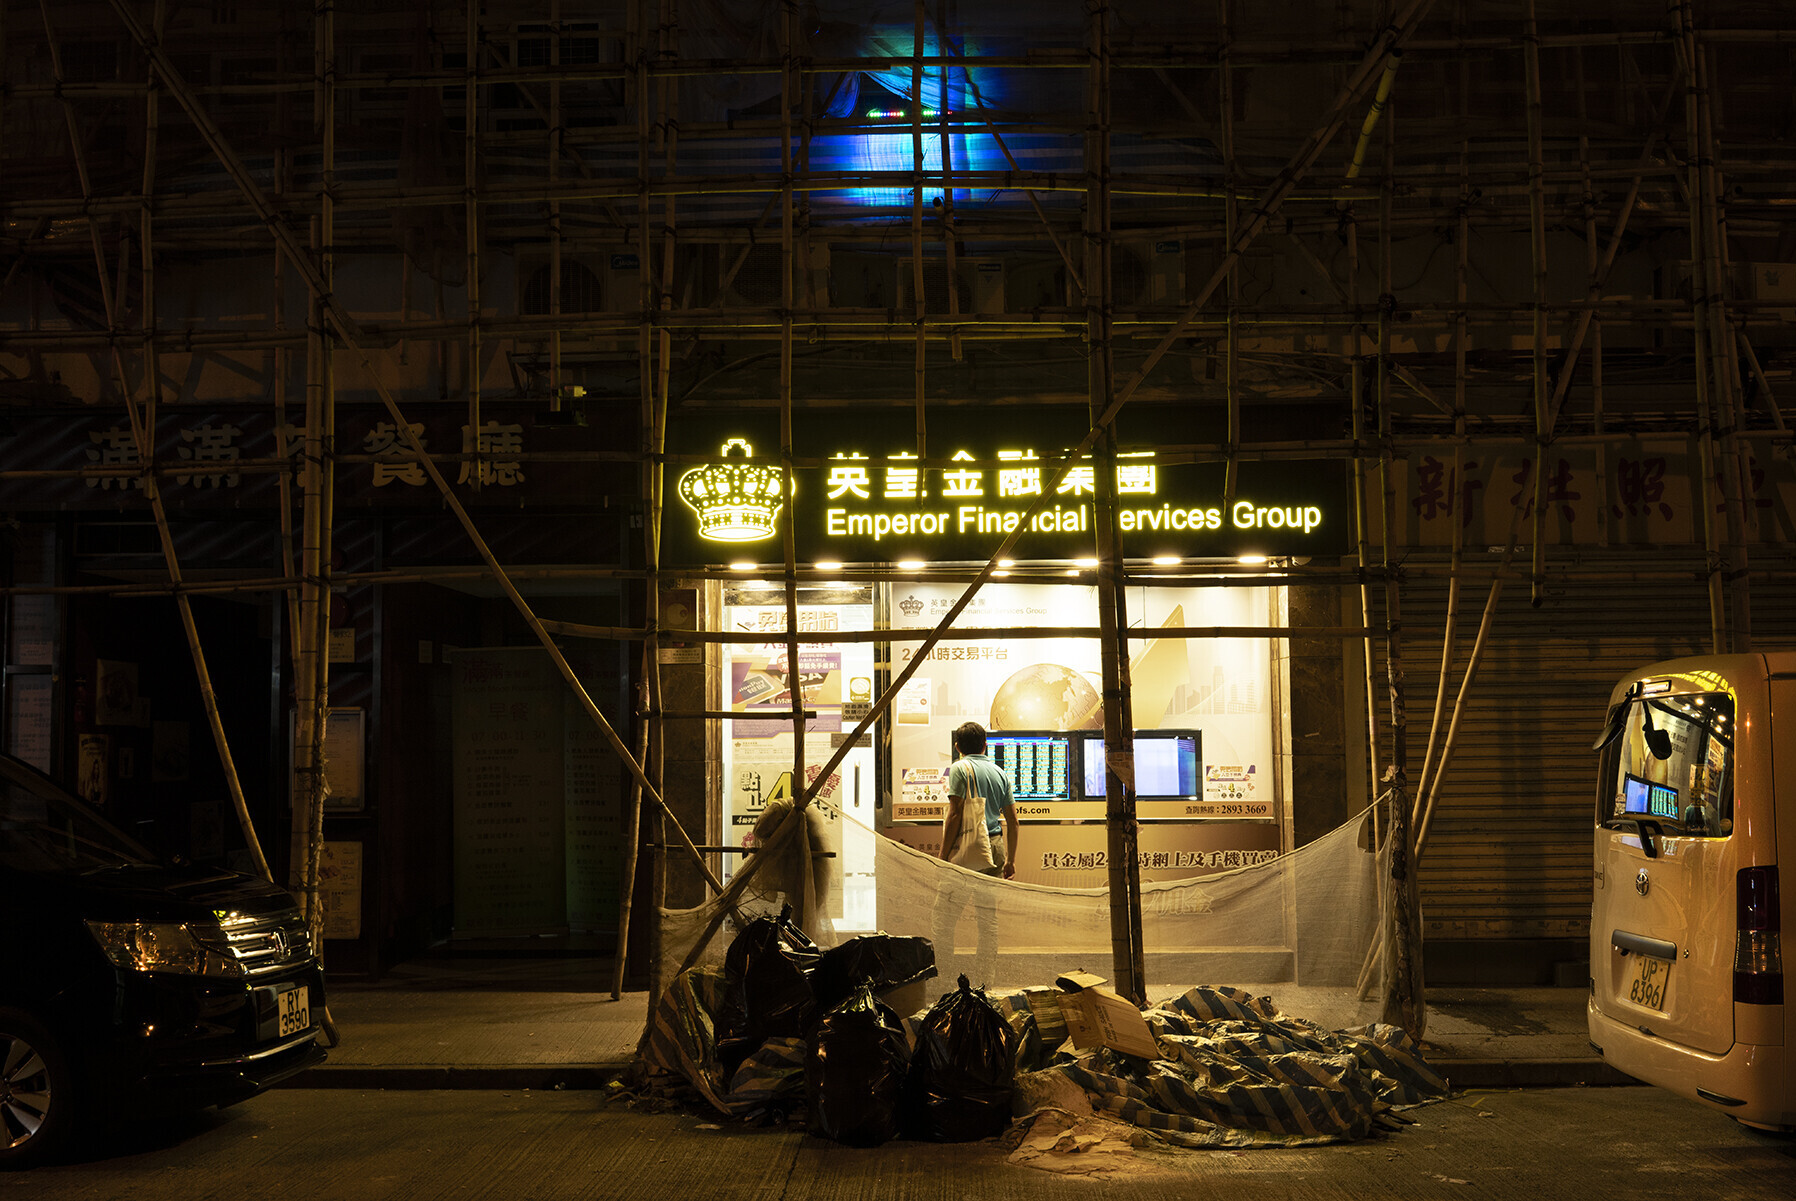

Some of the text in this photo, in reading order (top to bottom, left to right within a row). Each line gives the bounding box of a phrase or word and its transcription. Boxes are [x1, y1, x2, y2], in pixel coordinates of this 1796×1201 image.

[827, 500, 1323, 541] Emperor Financial ervices Group
[930, 598, 986, 608] 英皇金集團
[1025, 607, 1048, 616] Group
[901, 647, 1008, 661] 2小時交易平台
[898, 807, 944, 816] 英皇金融集團
[1221, 804, 1243, 815] 2893
[1245, 804, 1267, 815] 3669
[1041, 850, 1280, 870] 貴金屬2時網上及手機買賣
[1642, 958, 1658, 982] UP
[287, 989, 300, 1012] RY
[1631, 979, 1660, 1008] 8396
[282, 1007, 308, 1035] 3590
